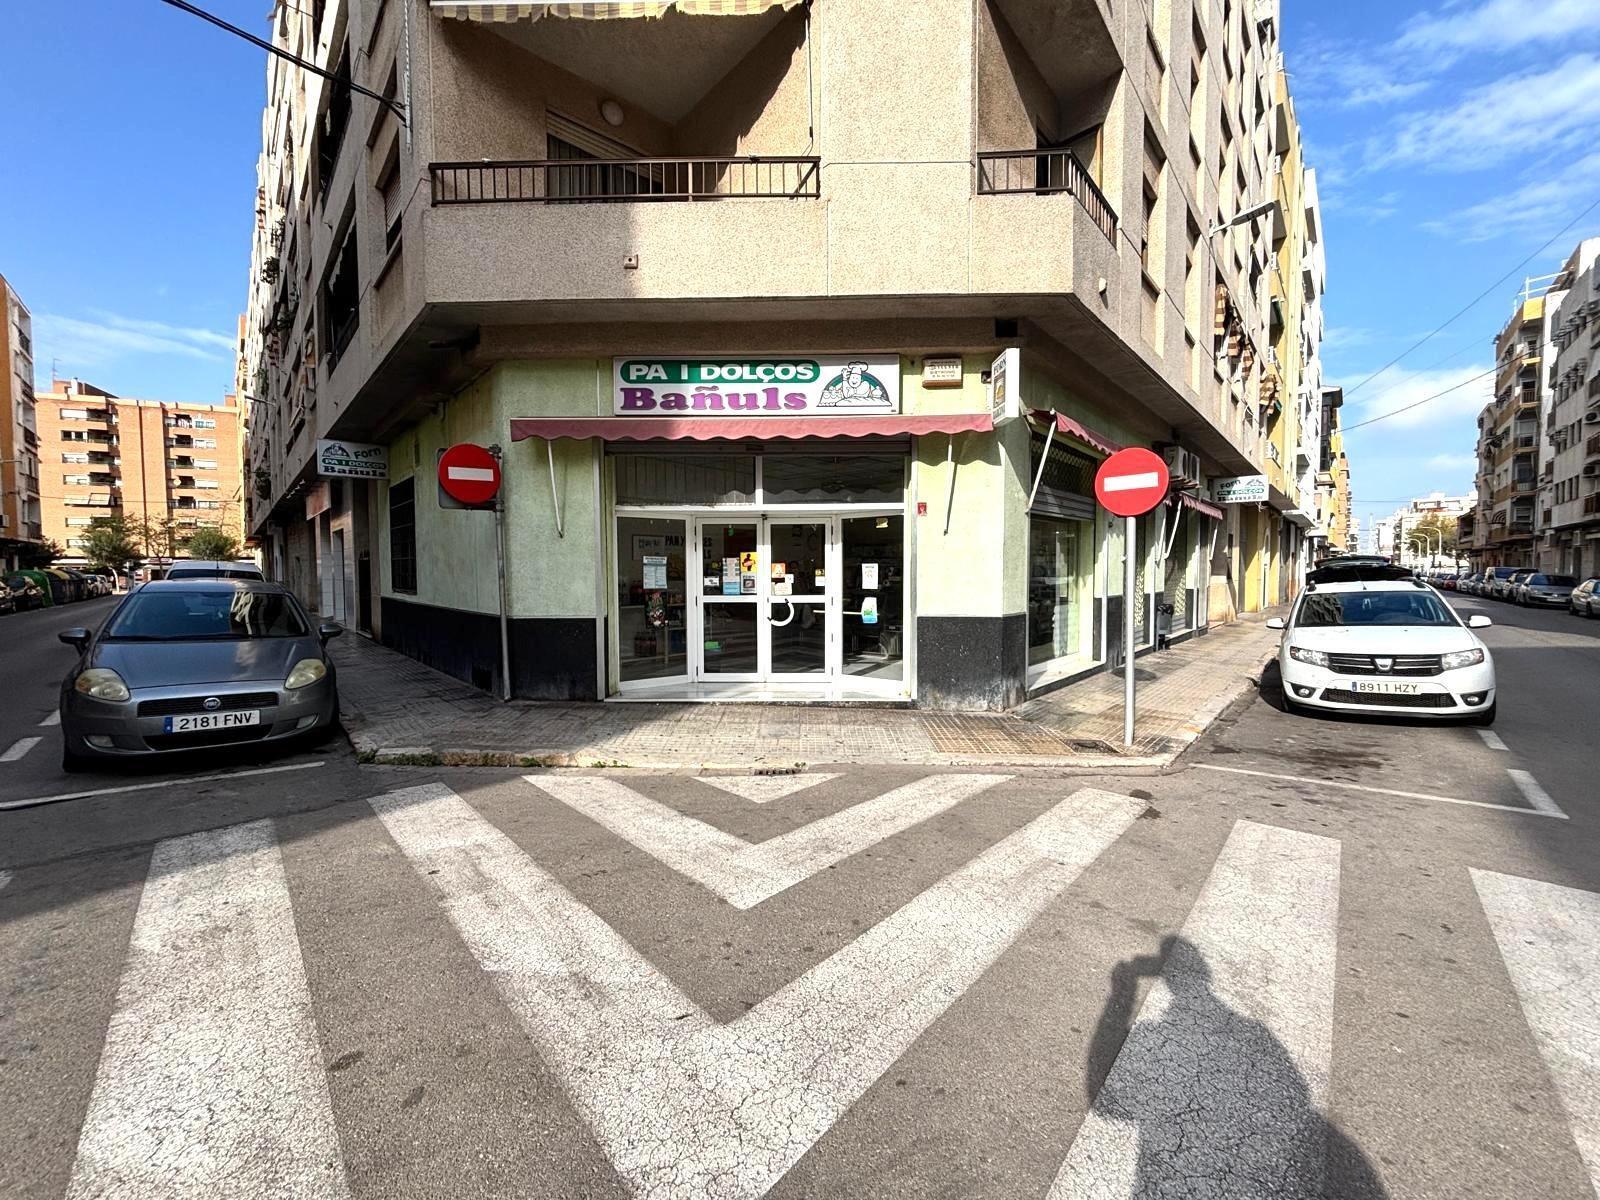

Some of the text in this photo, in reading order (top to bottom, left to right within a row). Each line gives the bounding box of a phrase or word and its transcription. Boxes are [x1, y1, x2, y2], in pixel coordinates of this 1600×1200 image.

[629, 362, 815, 383] PA I DOLÇOS
[620, 385, 808, 411] Bañuls
[353, 447, 382, 459] Forn
[323, 465, 386, 477] Bañuls
[1359, 683, 1418, 693] 8911 HZY
[179, 712, 253, 730] 2181 FNV
